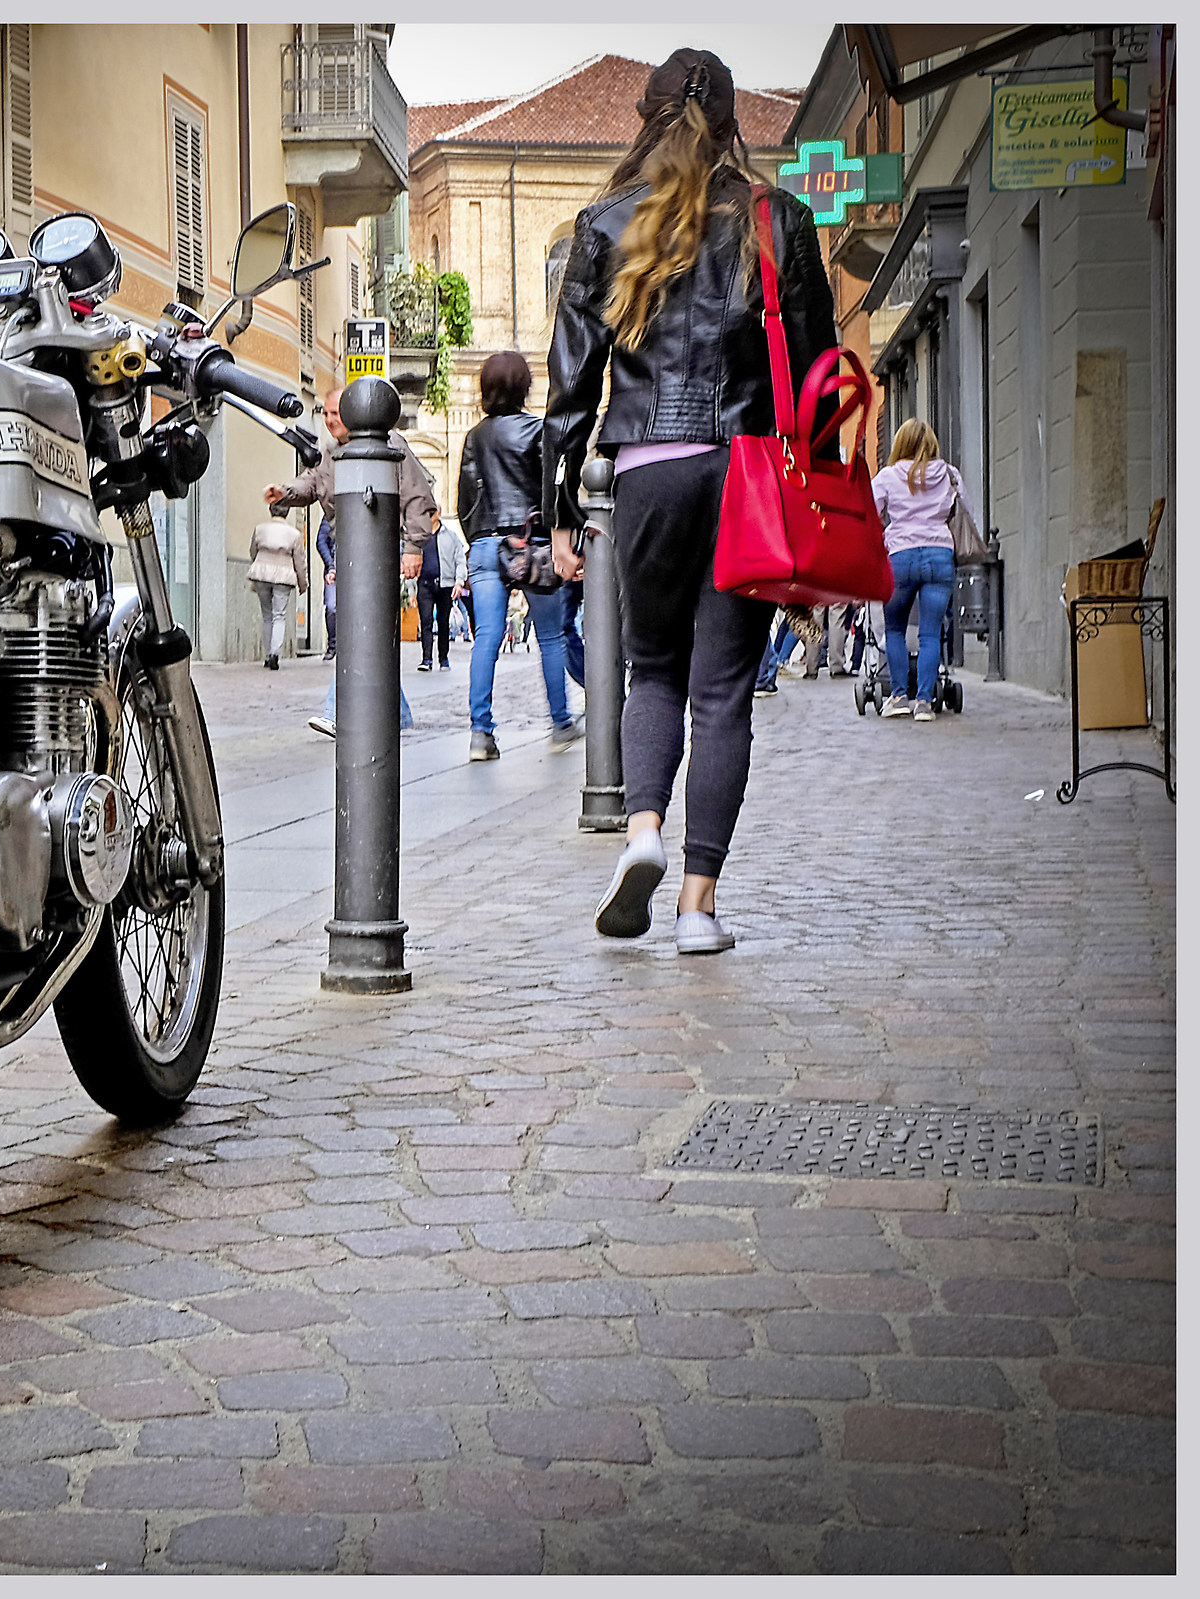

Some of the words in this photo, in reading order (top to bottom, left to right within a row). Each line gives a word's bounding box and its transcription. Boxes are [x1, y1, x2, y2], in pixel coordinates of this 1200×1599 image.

[998, 89, 1094, 114] Esteticamente
[1004, 104, 1090, 137] Gisella
[998, 139, 1045, 151] estetica
[1050, 138, 1059, 149] &
[1064, 135, 1119, 148] solarium
[348, 358, 383, 372] LOTTO
